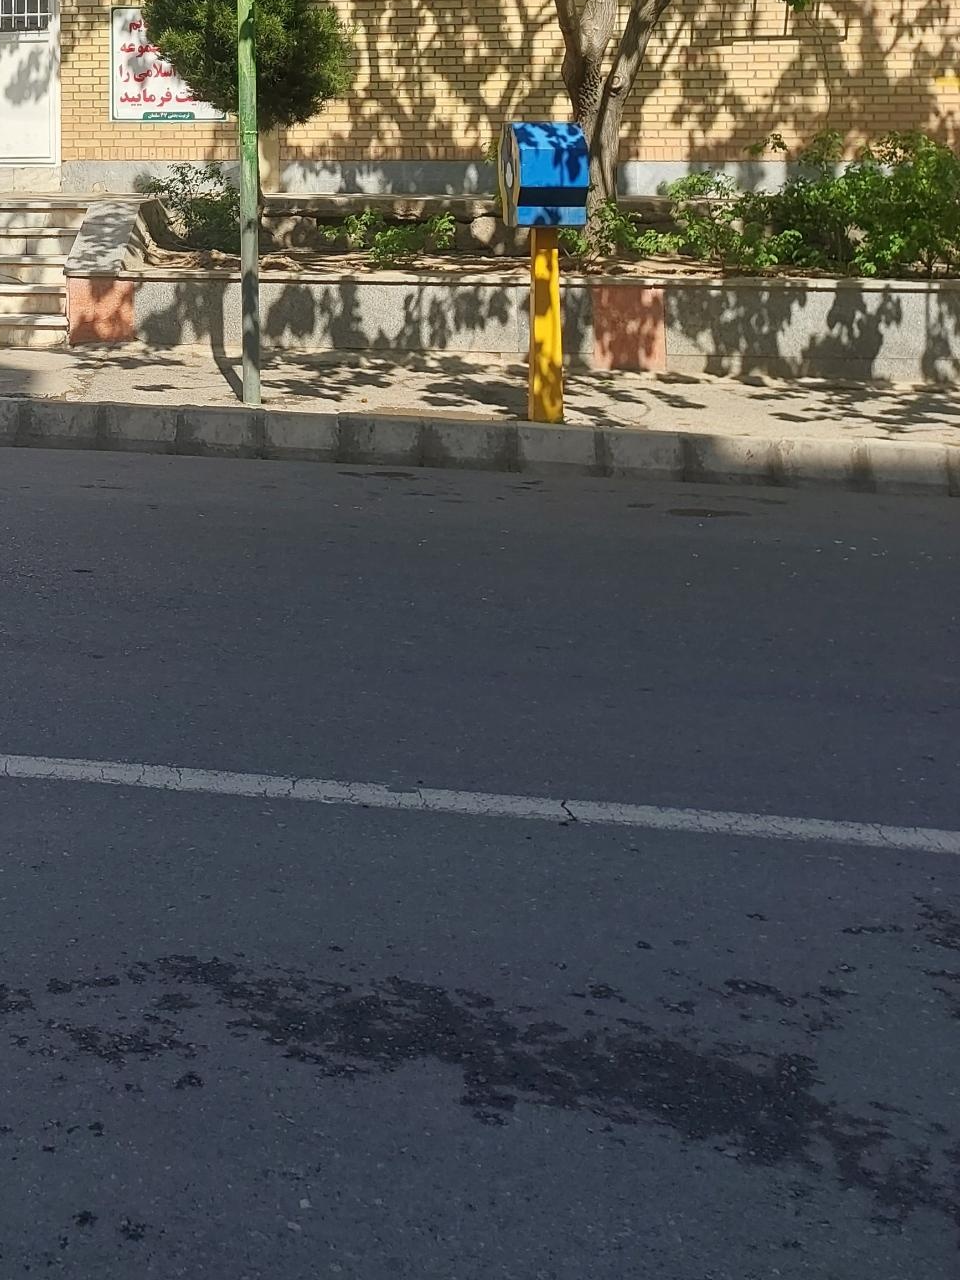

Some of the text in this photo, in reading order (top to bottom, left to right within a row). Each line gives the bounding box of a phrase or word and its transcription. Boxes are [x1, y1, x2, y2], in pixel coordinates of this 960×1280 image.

[120, 43, 161, 58] موعه
[118, 63, 176, 82] اسلامی را
[120, 87, 172, 107] فرمایید
